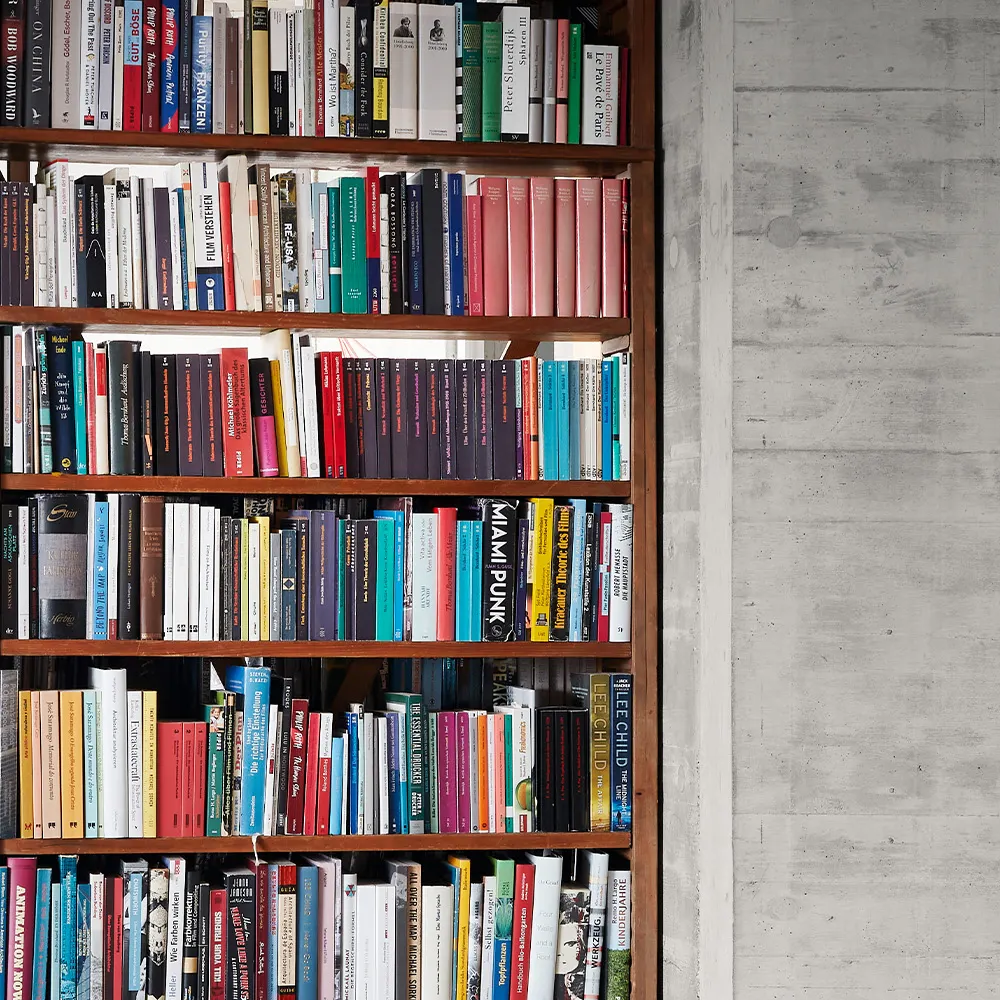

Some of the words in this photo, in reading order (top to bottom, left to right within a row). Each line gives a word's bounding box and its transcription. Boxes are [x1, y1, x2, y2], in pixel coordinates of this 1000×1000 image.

[32, 21, 43, 40] ON
[130, 8, 140, 36] BÖSE
[7, 28, 18, 51] BOB
[196, 30, 208, 64] Purity
[518, 30, 526, 66] Sphären
[32, 46, 43, 93] CHINA
[329, 48, 337, 81] Martha?
[504, 28, 516, 83] Sloterdijk
[596, 52, 604, 64] Le
[6, 54, 18, 120] WOODWARD
[329, 83, 337, 93] ist
[596, 68, 604, 92] Pavé
[196, 72, 206, 126] FRANZEN
[329, 94, 337, 108] Wo
[504, 86, 514, 112] Peter
[596, 96, 604, 108] de
[595, 112, 604, 138] Paris
[204, 195, 214, 240] VERSTEHEN
[206, 242, 215, 261] FILM
[284, 223, 293, 264] RE-USA
[491, 503, 508, 564] MIAMI
[558, 508, 570, 532] Films
[558, 534, 568, 548] des
[556, 550, 568, 584] Theorie
[489, 570, 507, 624] PUNK
[554, 588, 566, 630] Kracauer
[252, 691, 262, 730] Einstellung
[412, 702, 421, 715] THE
[593, 684, 606, 714] LEE
[616, 692, 628, 719] LEE
[250, 732, 261, 760] richtige
[412, 716, 421, 752] ESSENTIAL
[594, 719, 606, 770] CHILD
[616, 722, 628, 767] CHILD
[131, 720, 140, 782] Extrastatecraft
[250, 762, 258, 774] Die
[412, 753, 421, 784] DRUCKER
[410, 872, 418, 886] ALL
[171, 892, 179, 918] wirken
[410, 887, 418, 906] OVER
[410, 908, 418, 922] THE
[618, 878, 626, 946] KINDERJAHRE
[14, 885, 26, 968] ANIMATION
[170, 920, 178, 946] Farben
[214, 912, 222, 942] FRIENDS
[409, 924, 418, 940] MAP
[214, 944, 222, 964] YOUR
[409, 945, 417, 976] MICHAEL
[498, 942, 508, 986] Topfpflanzen
[169, 976, 177, 998] Heller
[214, 966, 222, 982] KILL
